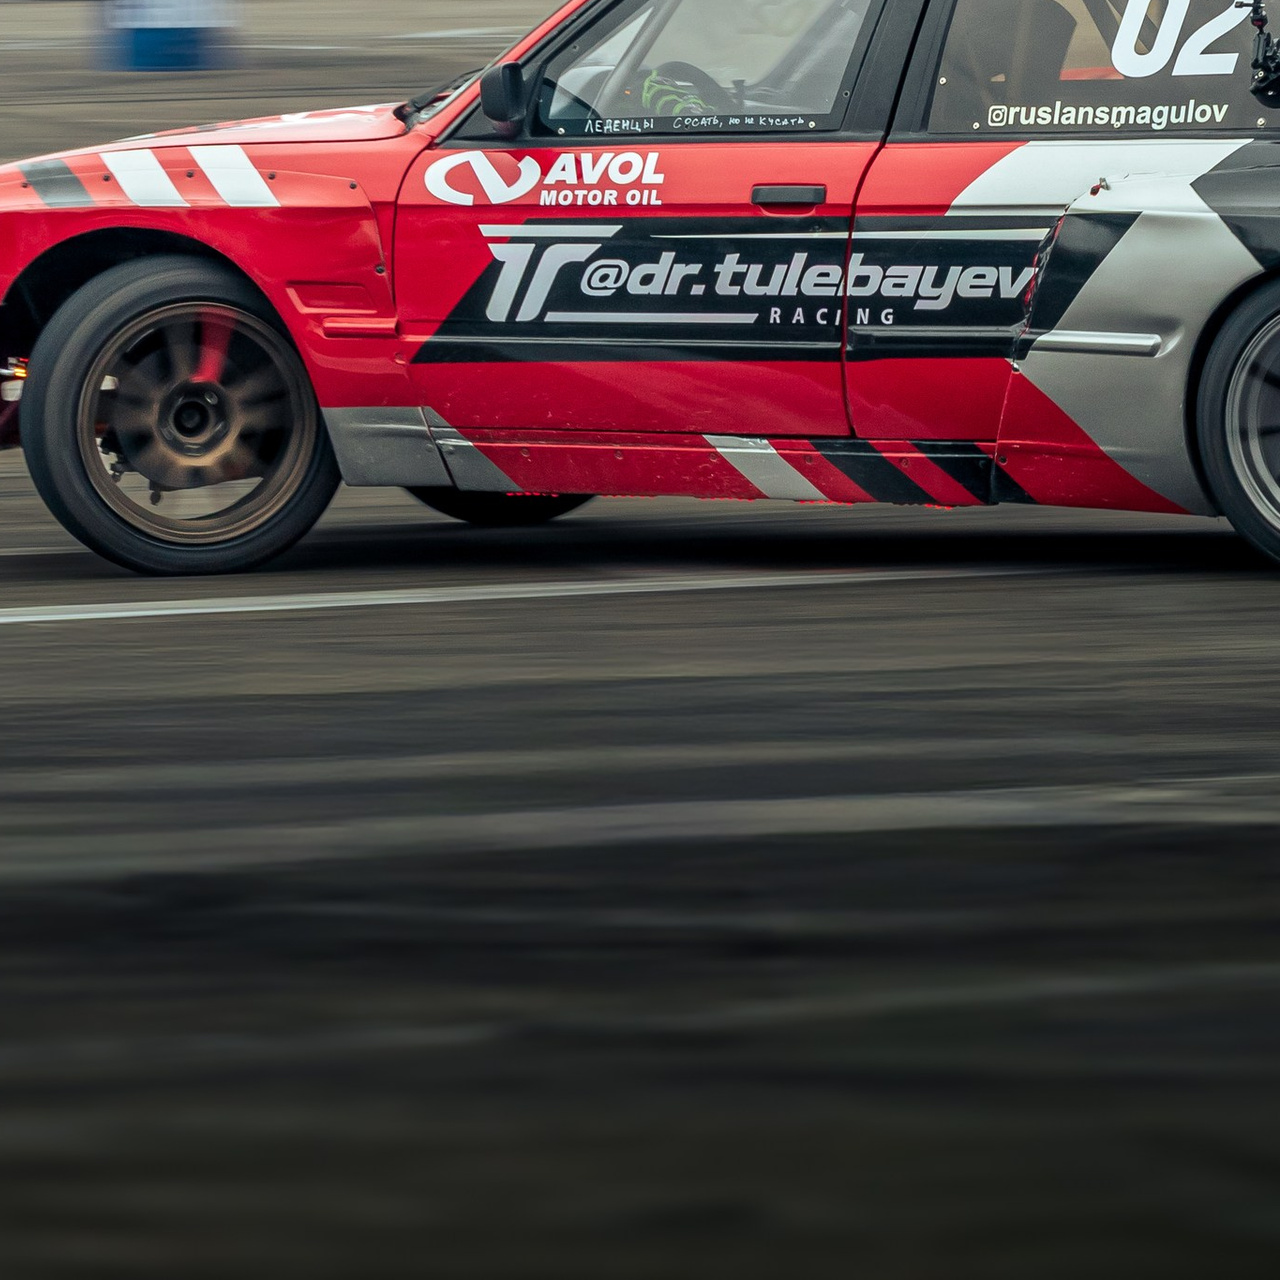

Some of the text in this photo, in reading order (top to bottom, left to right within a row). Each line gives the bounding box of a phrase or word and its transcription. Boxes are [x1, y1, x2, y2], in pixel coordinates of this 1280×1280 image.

[584, 117, 654, 134] ЛЕДЕНЦЫ
[543, 152, 665, 185] AVOL
[539, 189, 663, 207] MOTOR OIL
[579, 251, 1040, 311] @dr.tulebayev
[769, 307, 895, 327] RACING
